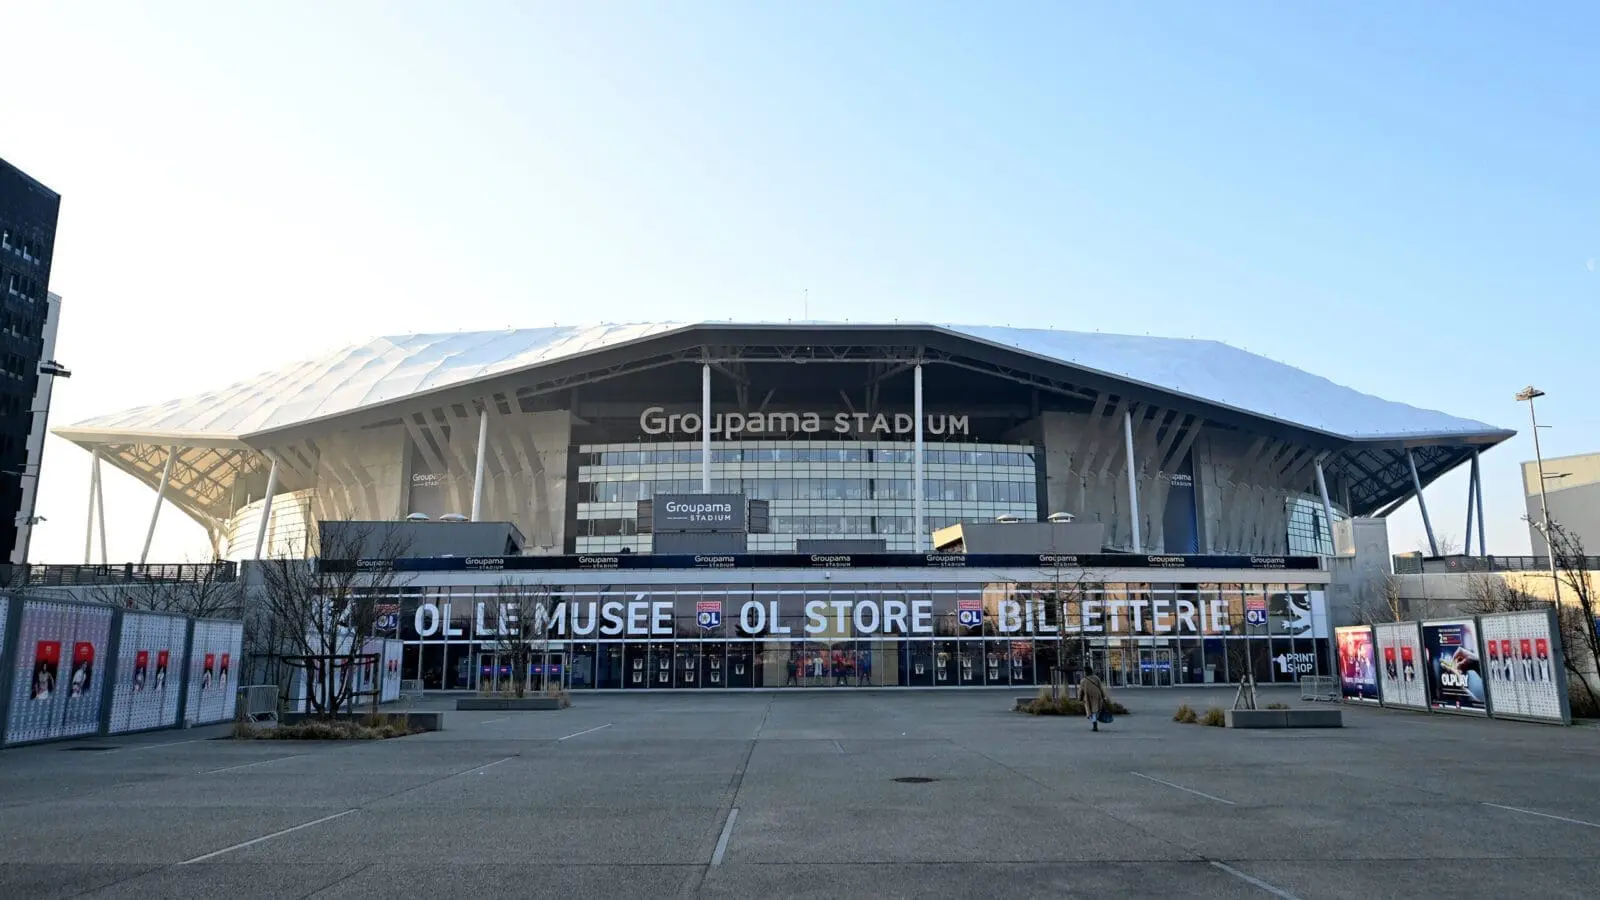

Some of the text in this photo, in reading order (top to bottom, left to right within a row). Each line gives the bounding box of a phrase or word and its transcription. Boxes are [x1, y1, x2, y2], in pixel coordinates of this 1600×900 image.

[640, 406, 969, 440] Groupama STADUM
[666, 501, 731, 514] Groupama
[465, 557, 504, 565] Groupama
[579, 556, 618, 564] Groupama
[694, 555, 734, 563] Groupama
[811, 554, 851, 562] Groupama
[926, 554, 965, 562] Groupama
[1147, 555, 1184, 563] Groupama
[1250, 556, 1285, 564] Groupama
[414, 594, 673, 637] OL LE MUSÉE
[699, 612, 719, 625] OL
[740, 600, 934, 634] OL STORE
[960, 611, 980, 623] OL
[998, 599, 1231, 632] BILLETTERIE
[1247, 610, 1265, 622] OL
[1286, 653, 1315, 663] PRINT
[1287, 663, 1313, 673] SHOP
